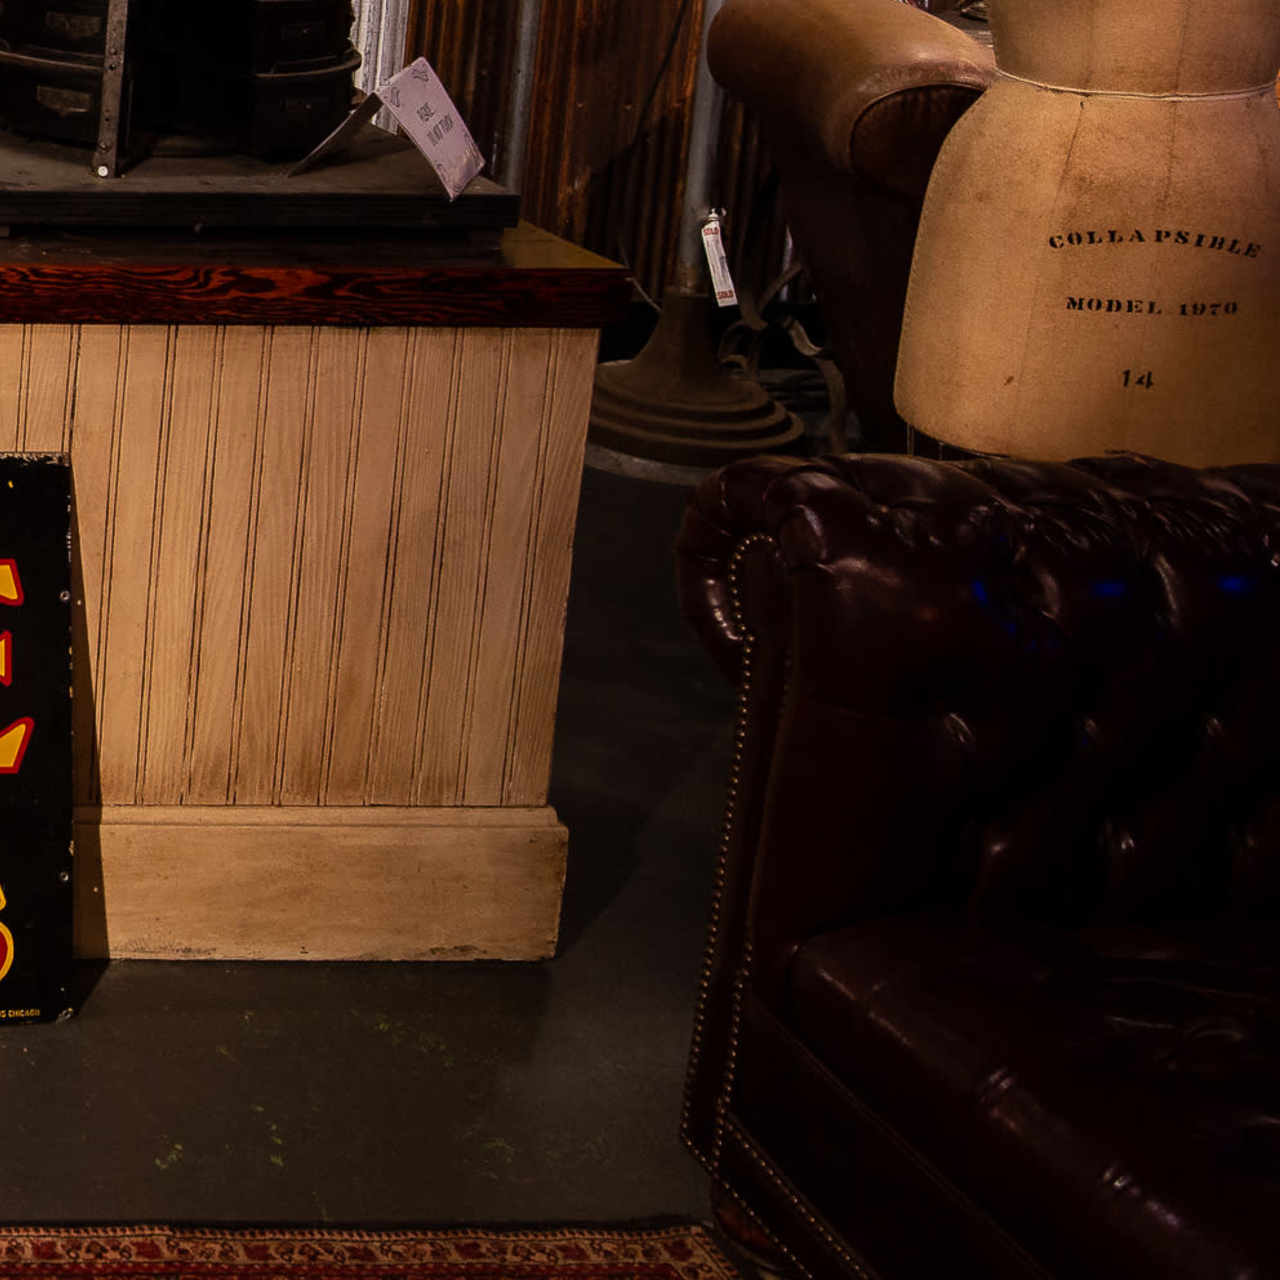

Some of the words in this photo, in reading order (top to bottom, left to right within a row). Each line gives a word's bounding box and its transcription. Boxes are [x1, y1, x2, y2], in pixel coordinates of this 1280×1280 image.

[1049, 229, 1262, 258] COLLAPSIBLE
[1066, 296, 1163, 314] MODEL
[1180, 302, 1238, 316] 1970
[1123, 369, 1155, 389] 14
